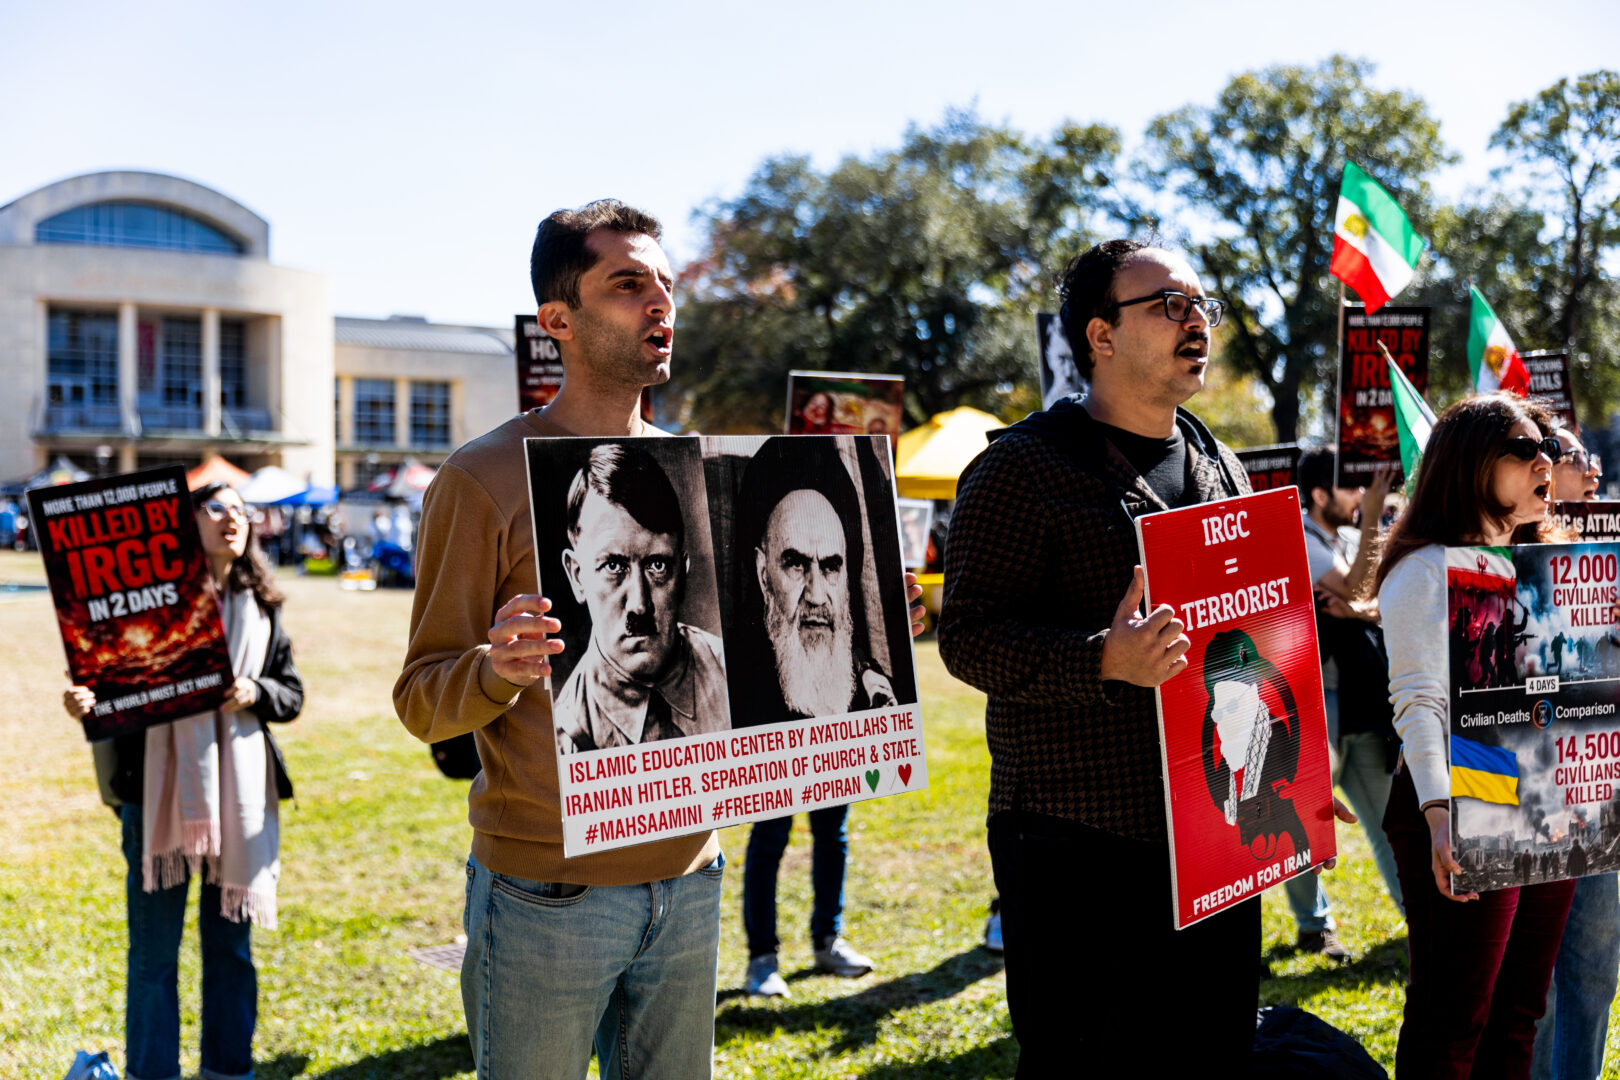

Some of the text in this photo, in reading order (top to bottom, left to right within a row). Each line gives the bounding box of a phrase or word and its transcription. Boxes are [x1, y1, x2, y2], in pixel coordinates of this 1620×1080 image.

[1347, 328, 1422, 352] KILLED BY
[1355, 388, 1393, 407] IN 2 DA
[1530, 373, 1562, 392] ITALS
[42, 479, 178, 516] MORE THAN 12,000 PEOPLE
[47, 497, 180, 552] KILLED BY
[1202, 510, 1250, 546] IRGC
[66, 533, 184, 600] IRGC
[1224, 558, 1238, 574] =
[1549, 553, 1617, 589] 12,000
[88, 582, 179, 622] IN 2 DAYS
[1180, 577, 1290, 632] TERRORIST
[1553, 586, 1617, 607] CIVILIANS
[1571, 606, 1617, 627] KILLED
[93, 672, 222, 717] THE WORLD MUST ACT NOW!
[1529, 679, 1556, 691] 4 DAYS
[1460, 703, 1615, 728] Civilian Deaths Comparison
[569, 712, 914, 784] ISLAMIC EDUCATION CENTER BY AYATOLLAHS THE
[1555, 731, 1620, 766] 14,500
[565, 738, 921, 816] IRANIAN HITLER. SEPARATION OF CHURCH & STATE.
[1555, 762, 1620, 786] CIVILIANS
[584, 775, 861, 845] #MAHSAAMINI #FREEIRAN #OPIRAN
[1565, 783, 1613, 806] KILLED
[1193, 849, 1311, 915] FREEDOM FOR IRAN
